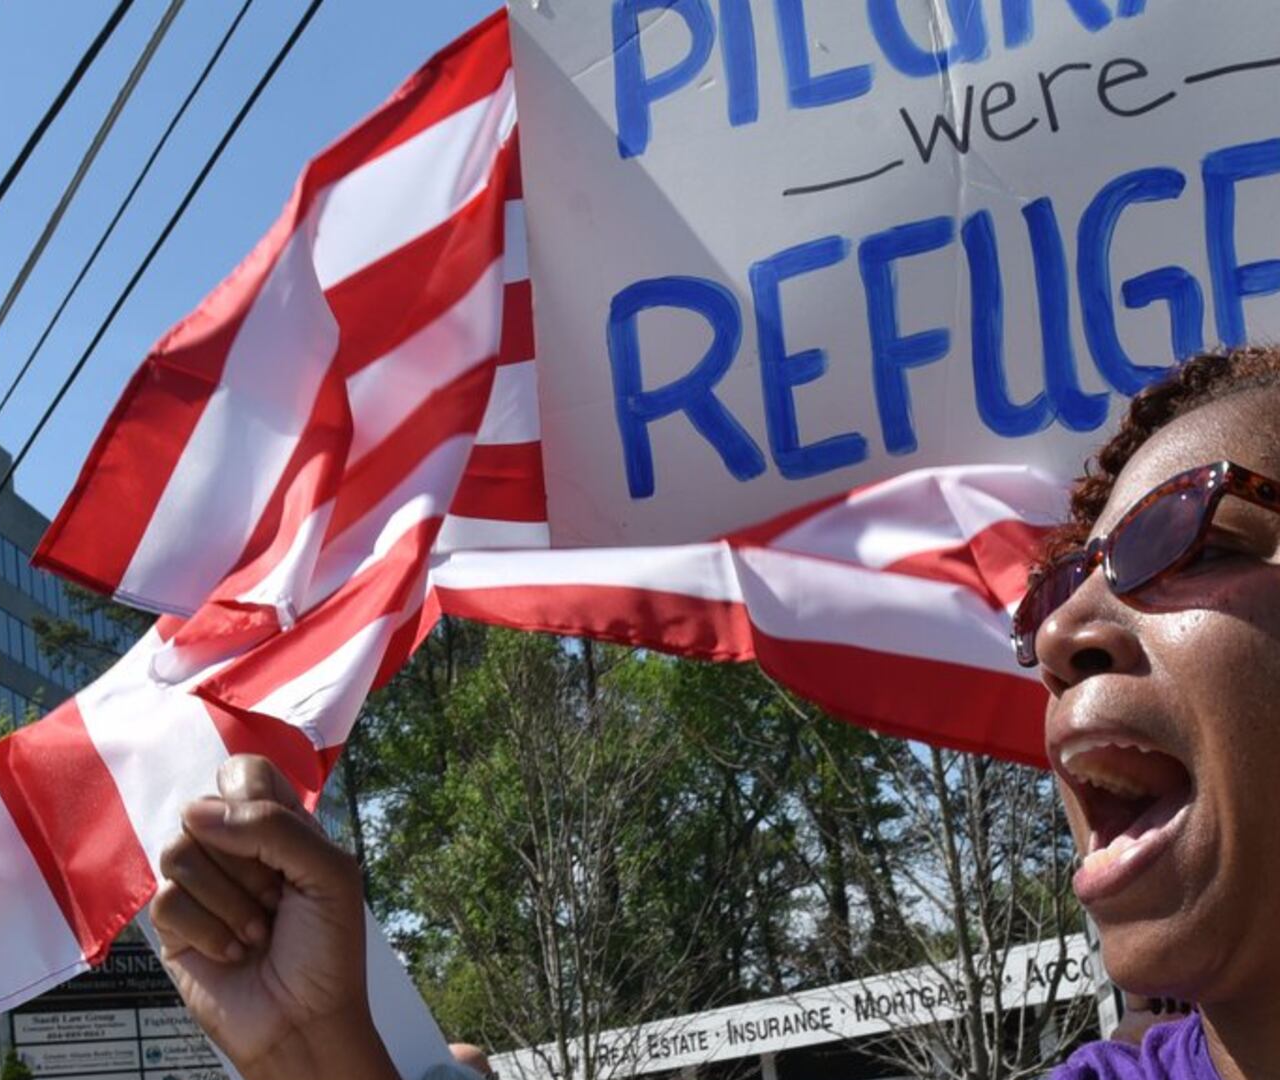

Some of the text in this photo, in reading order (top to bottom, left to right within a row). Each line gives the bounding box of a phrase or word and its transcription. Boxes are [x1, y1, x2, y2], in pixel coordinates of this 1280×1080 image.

[610, 0, 1148, 160] PIL
[899, 56, 1177, 164] were
[88, 954, 160, 975] USINE
[647, 1030, 709, 1059] ESTATE
[727, 1007, 833, 1046] INSURANCE
